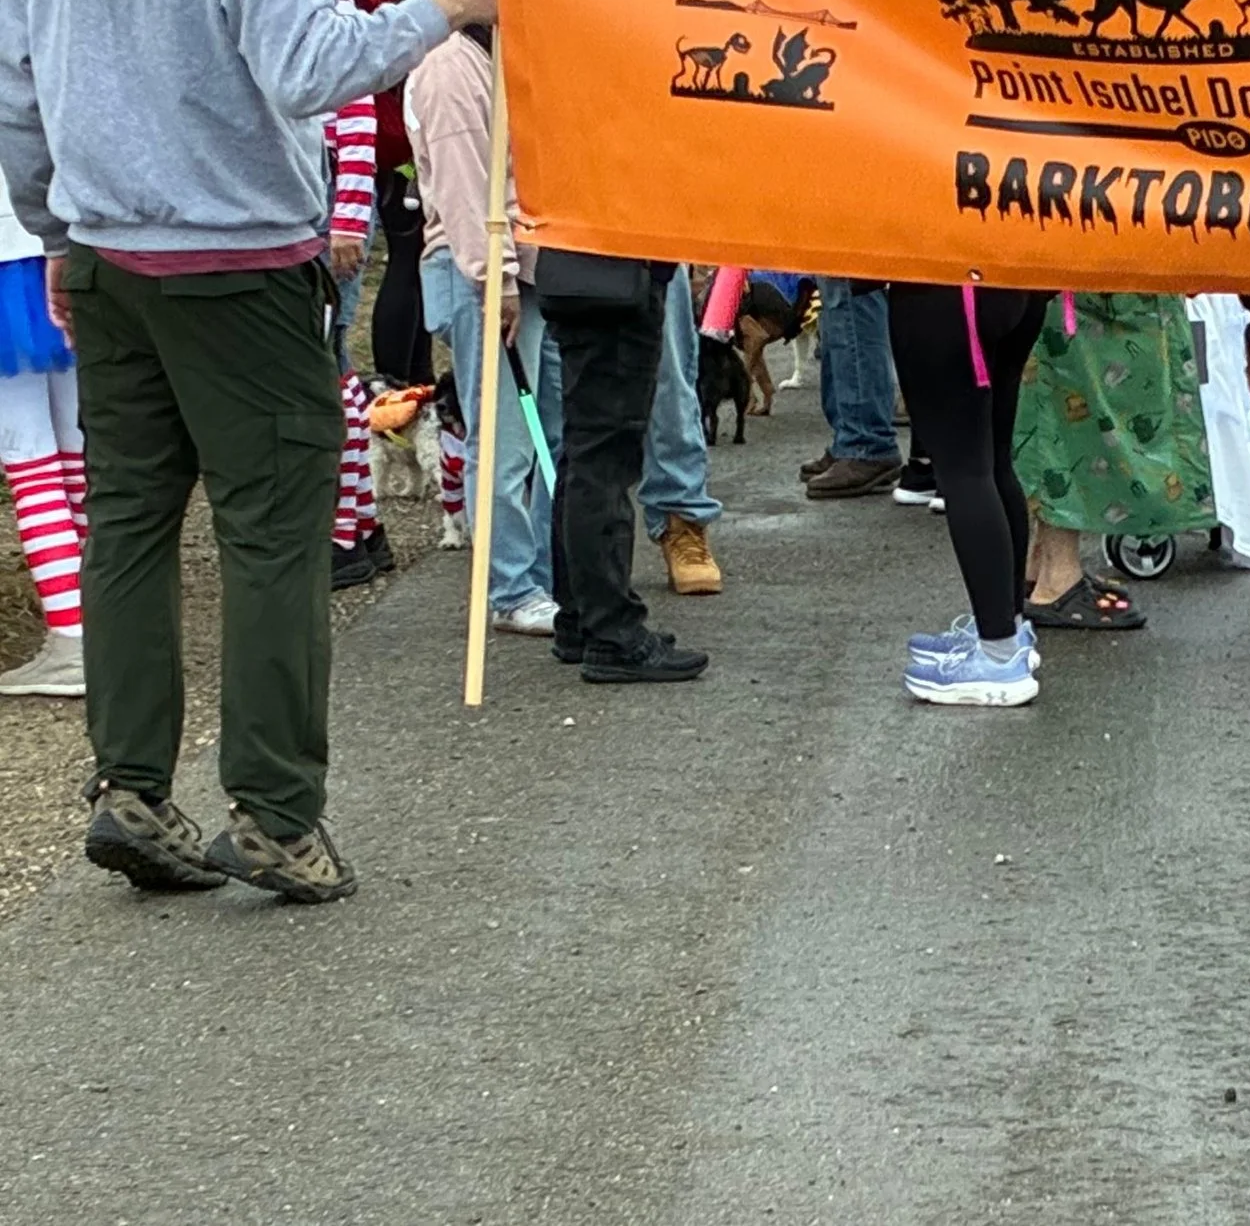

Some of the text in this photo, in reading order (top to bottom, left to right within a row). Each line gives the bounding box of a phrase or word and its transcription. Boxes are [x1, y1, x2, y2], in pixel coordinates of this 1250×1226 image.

[1071, 41, 1235, 59] ESTABLISHED
[971, 60, 1073, 105] Point
[1081, 70, 1197, 118] Isabel
[1187, 127, 1246, 150] PIDO
